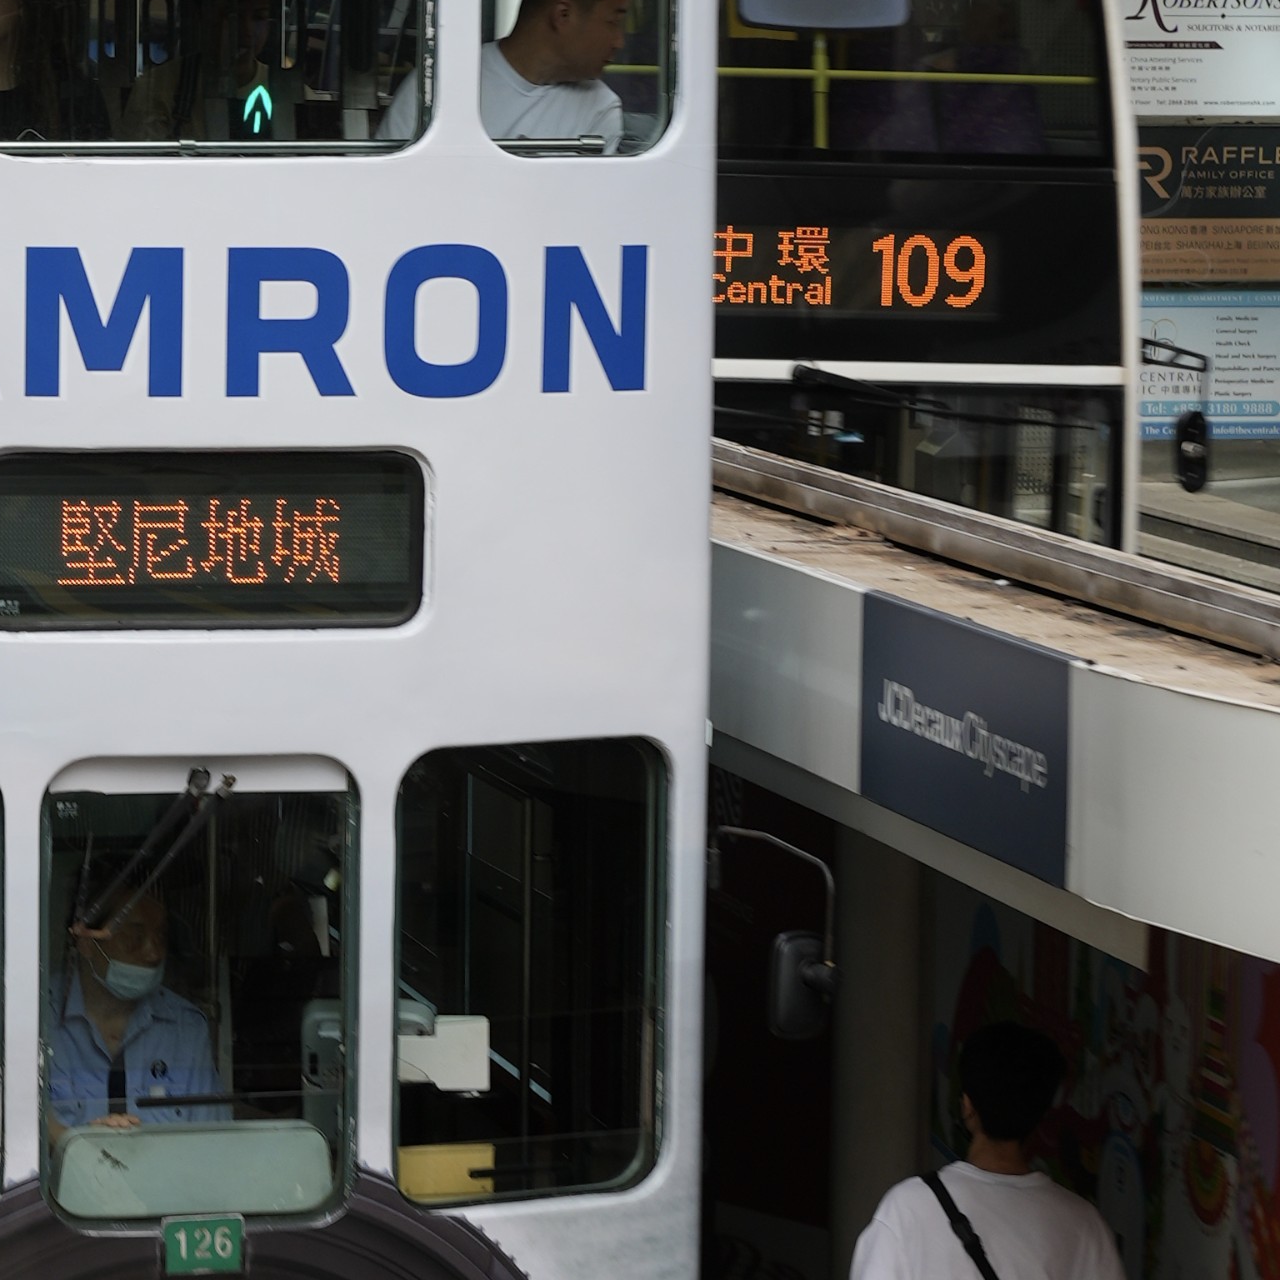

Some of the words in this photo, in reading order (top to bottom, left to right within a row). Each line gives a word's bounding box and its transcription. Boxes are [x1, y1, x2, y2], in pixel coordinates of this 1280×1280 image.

[1181, 170, 1225, 179] FAMILY
[1229, 170, 1275, 180] OFFICE
[1212, 225, 1264, 234] SINGAPORE
[712, 225, 831, 274] 中環
[872, 233, 986, 308] 109
[1146, 403, 1167, 414] Tel:
[1208, 403, 1237, 414] 3180
[1243, 403, 1273, 414] 9888
[57, 498, 342, 586] 堅尼地城
[174, 1225, 233, 1261] 126
